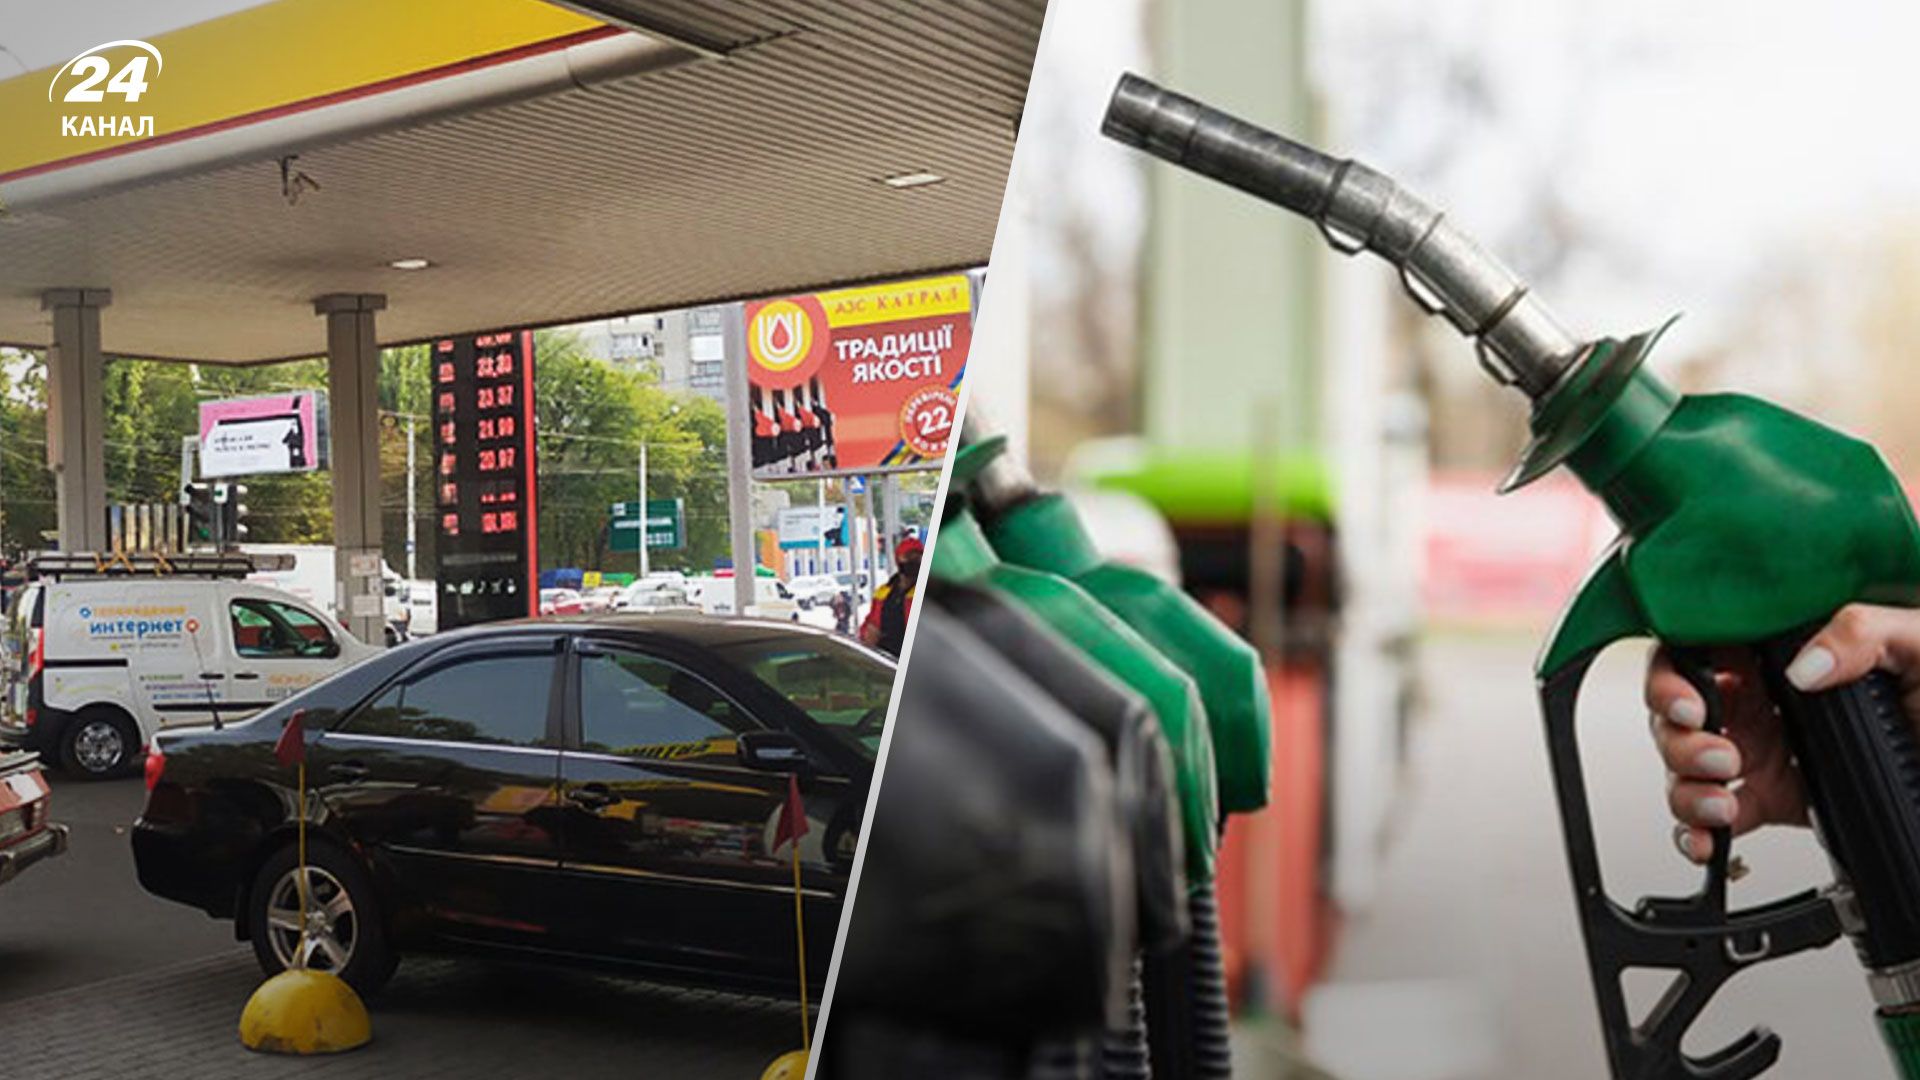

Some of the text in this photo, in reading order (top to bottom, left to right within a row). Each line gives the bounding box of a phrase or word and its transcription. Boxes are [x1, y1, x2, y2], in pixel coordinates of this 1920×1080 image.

[835, 299, 867, 314] АЗС
[833, 324, 954, 360] ТРАДИЦІЇ
[852, 355, 942, 383] ЯКОСТІ
[917, 405, 952, 435] 22
[90, 619, 183, 640] интернет
